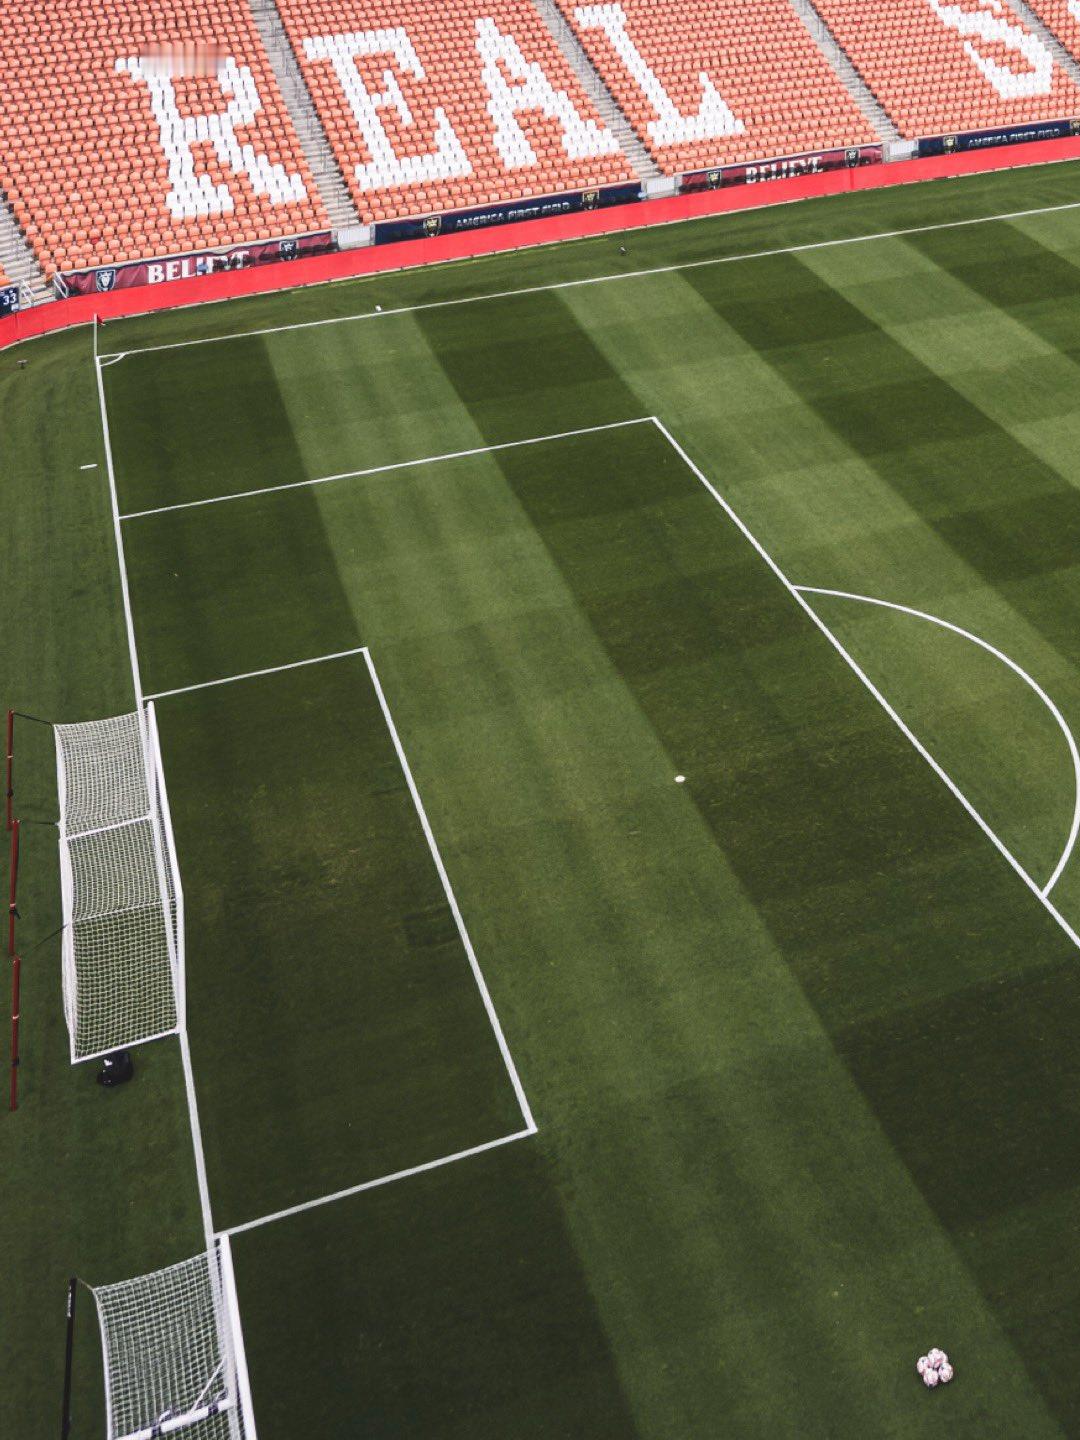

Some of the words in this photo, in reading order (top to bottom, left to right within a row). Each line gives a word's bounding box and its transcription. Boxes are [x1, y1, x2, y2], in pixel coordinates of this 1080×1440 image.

[115, 3, 745, 219] REAL
[456, 212, 504, 228] AMERICA
[508, 207, 539, 220] FIRST
[541, 201, 570, 215] FIELD
